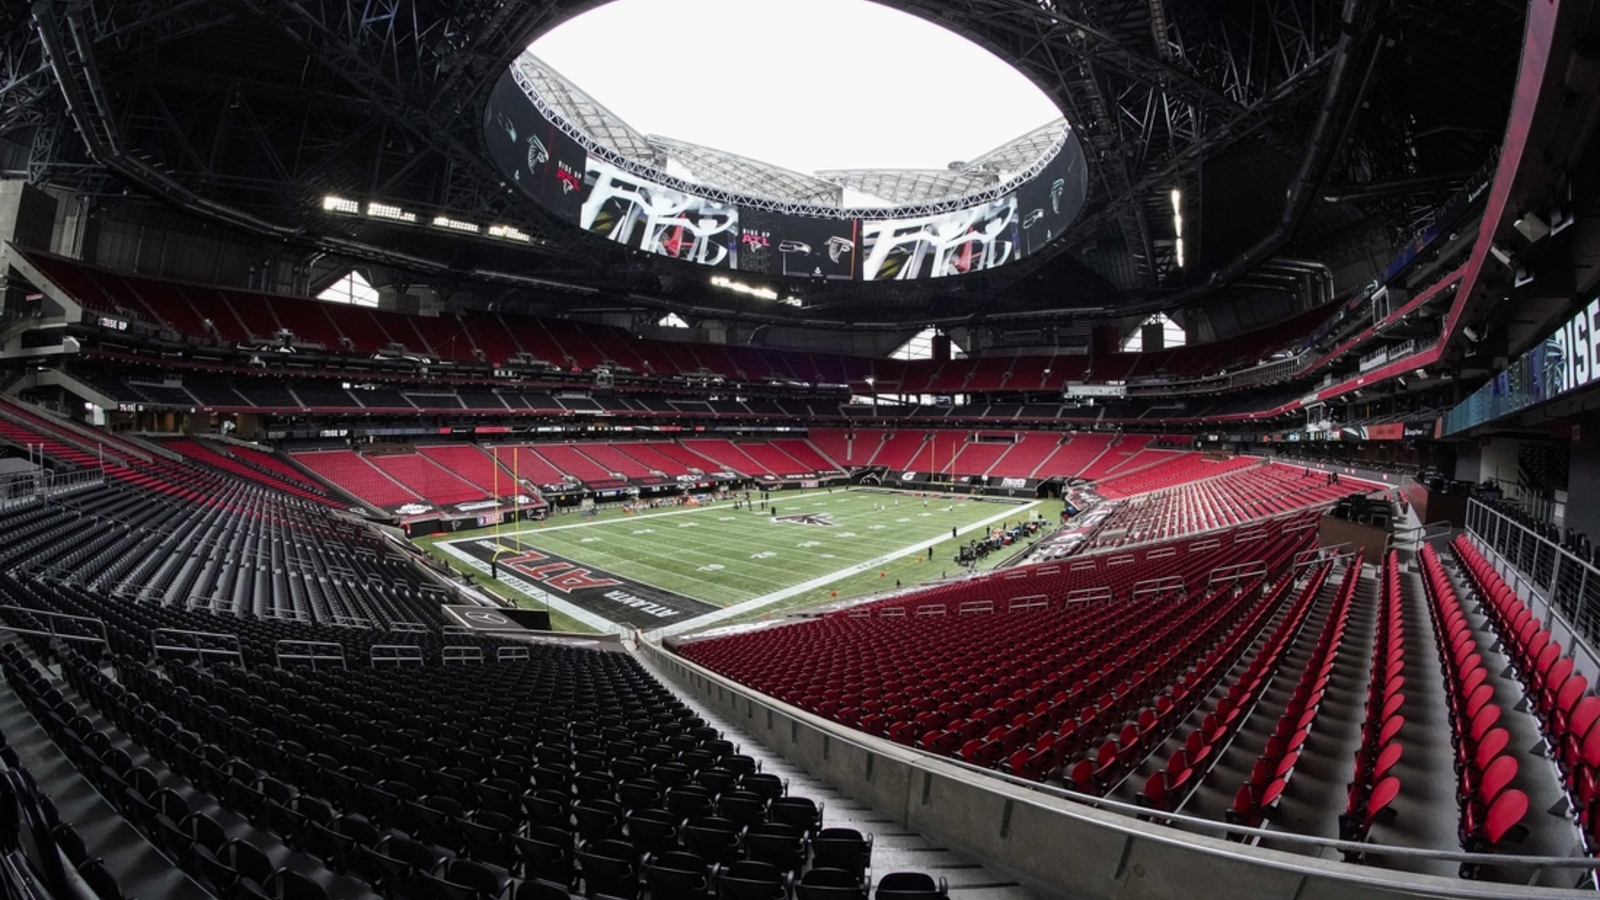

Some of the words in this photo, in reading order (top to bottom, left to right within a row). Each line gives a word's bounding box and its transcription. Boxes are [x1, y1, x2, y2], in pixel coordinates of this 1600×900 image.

[741, 234, 770, 247] ATL
[497, 549, 625, 594] ATL
[603, 590, 680, 618] ATLANTA
